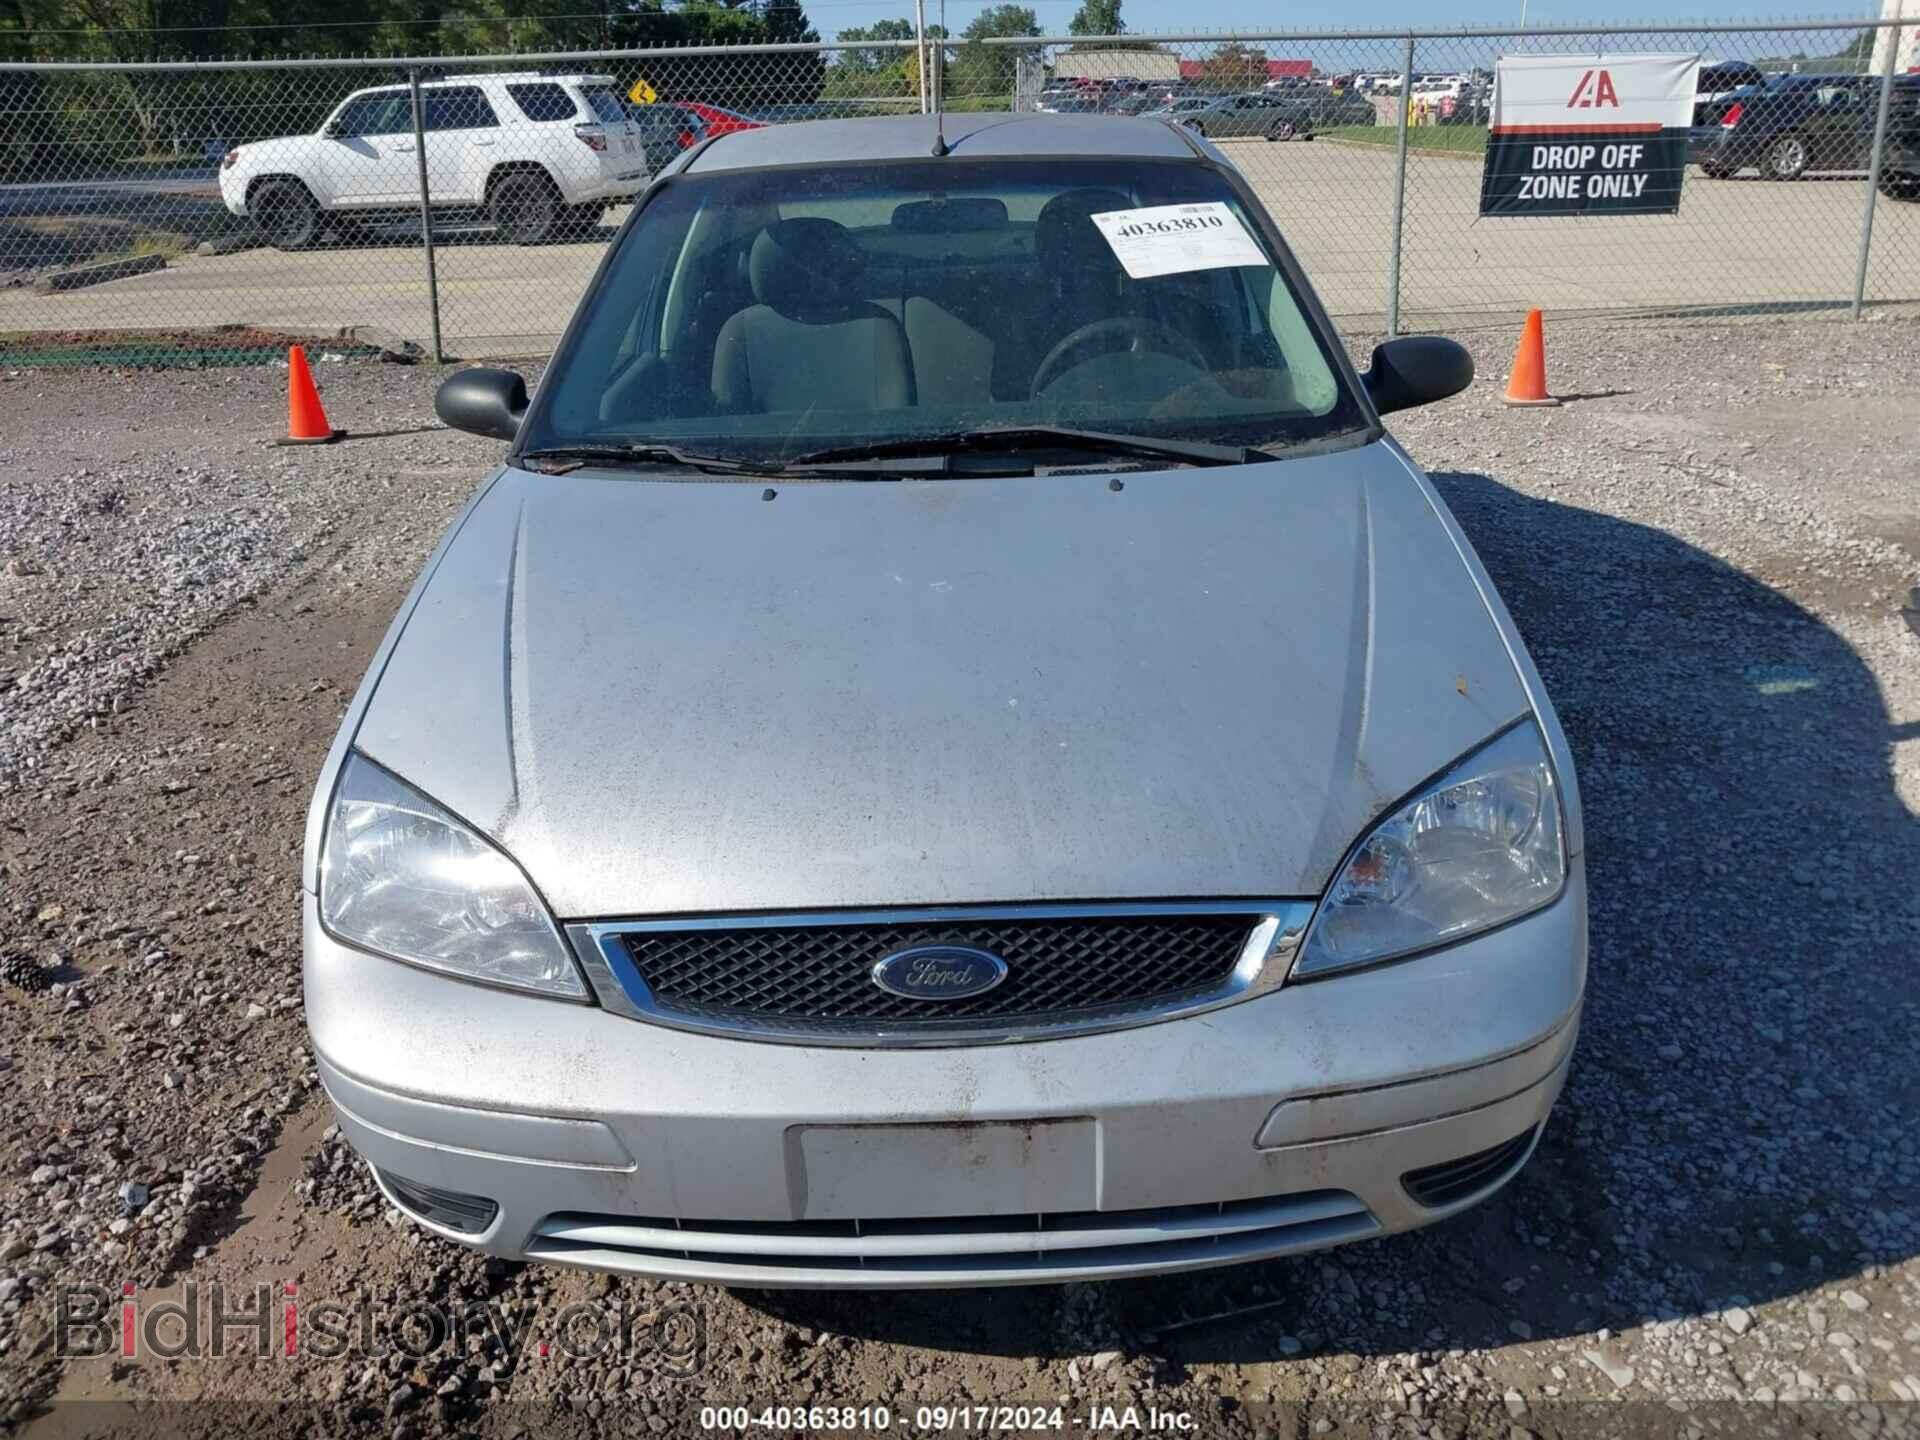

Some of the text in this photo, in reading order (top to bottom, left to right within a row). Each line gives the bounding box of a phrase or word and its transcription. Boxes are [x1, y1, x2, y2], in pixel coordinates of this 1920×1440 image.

[1532, 145, 1643, 169] DROP OFF
[1518, 174, 1648, 199] ZONE ONLY
[1117, 215, 1223, 238] 40363810
[905, 958, 974, 986] Ford
